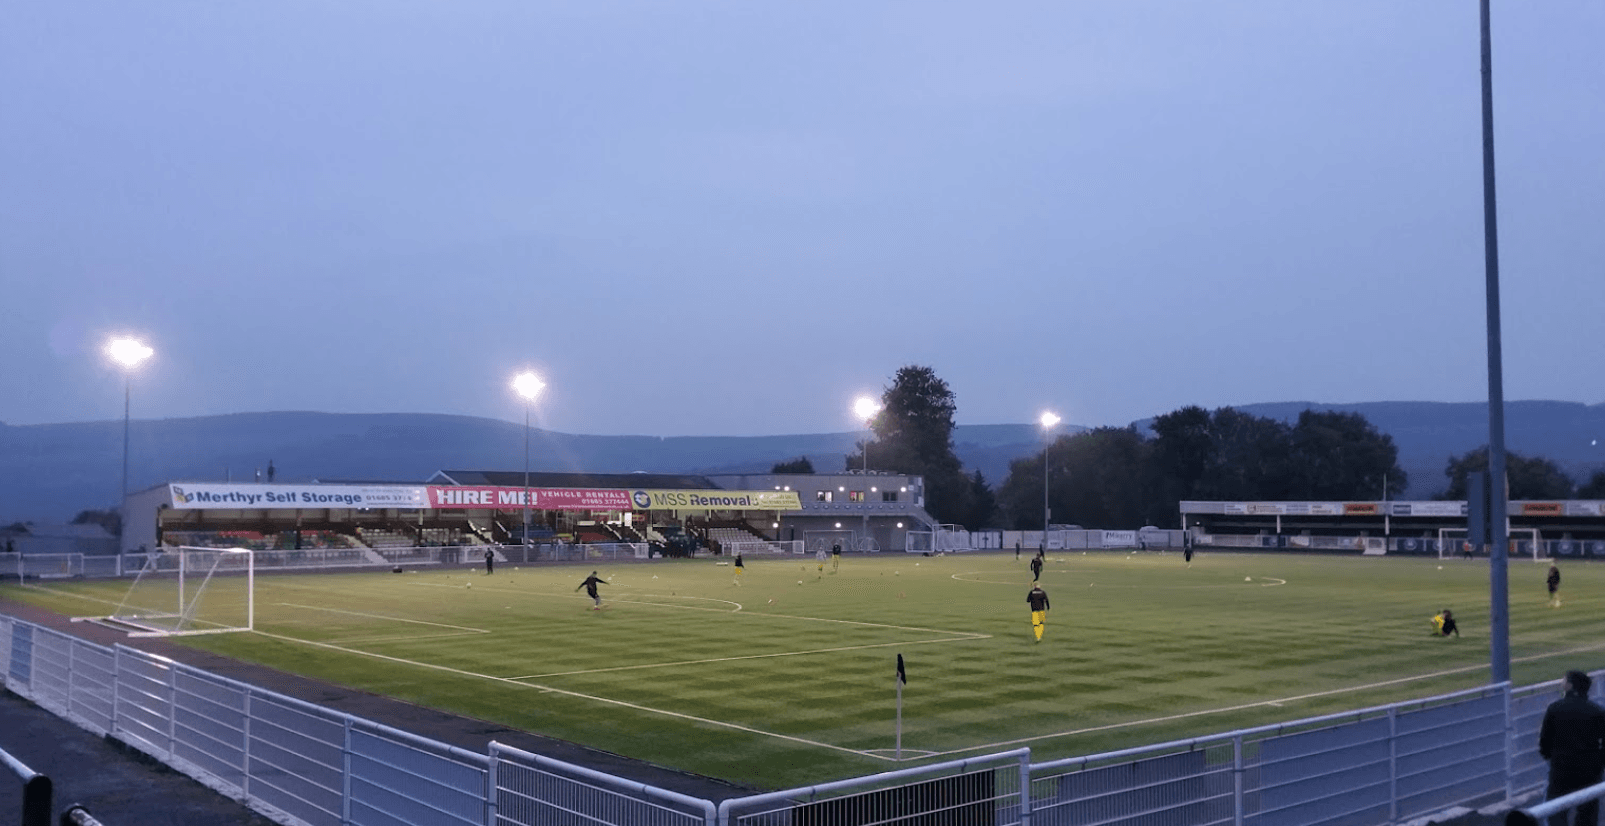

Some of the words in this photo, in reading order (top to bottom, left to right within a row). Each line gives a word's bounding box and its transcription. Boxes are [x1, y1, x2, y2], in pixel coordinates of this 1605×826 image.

[196, 491, 262, 504] Merthyr
[265, 491, 297, 502] Self
[301, 491, 362, 504] Storage
[437, 490, 494, 505] HIRE
[498, 490, 538, 505] ME!
[585, 491, 626, 499] RENTALS
[654, 493, 688, 506] MSS
